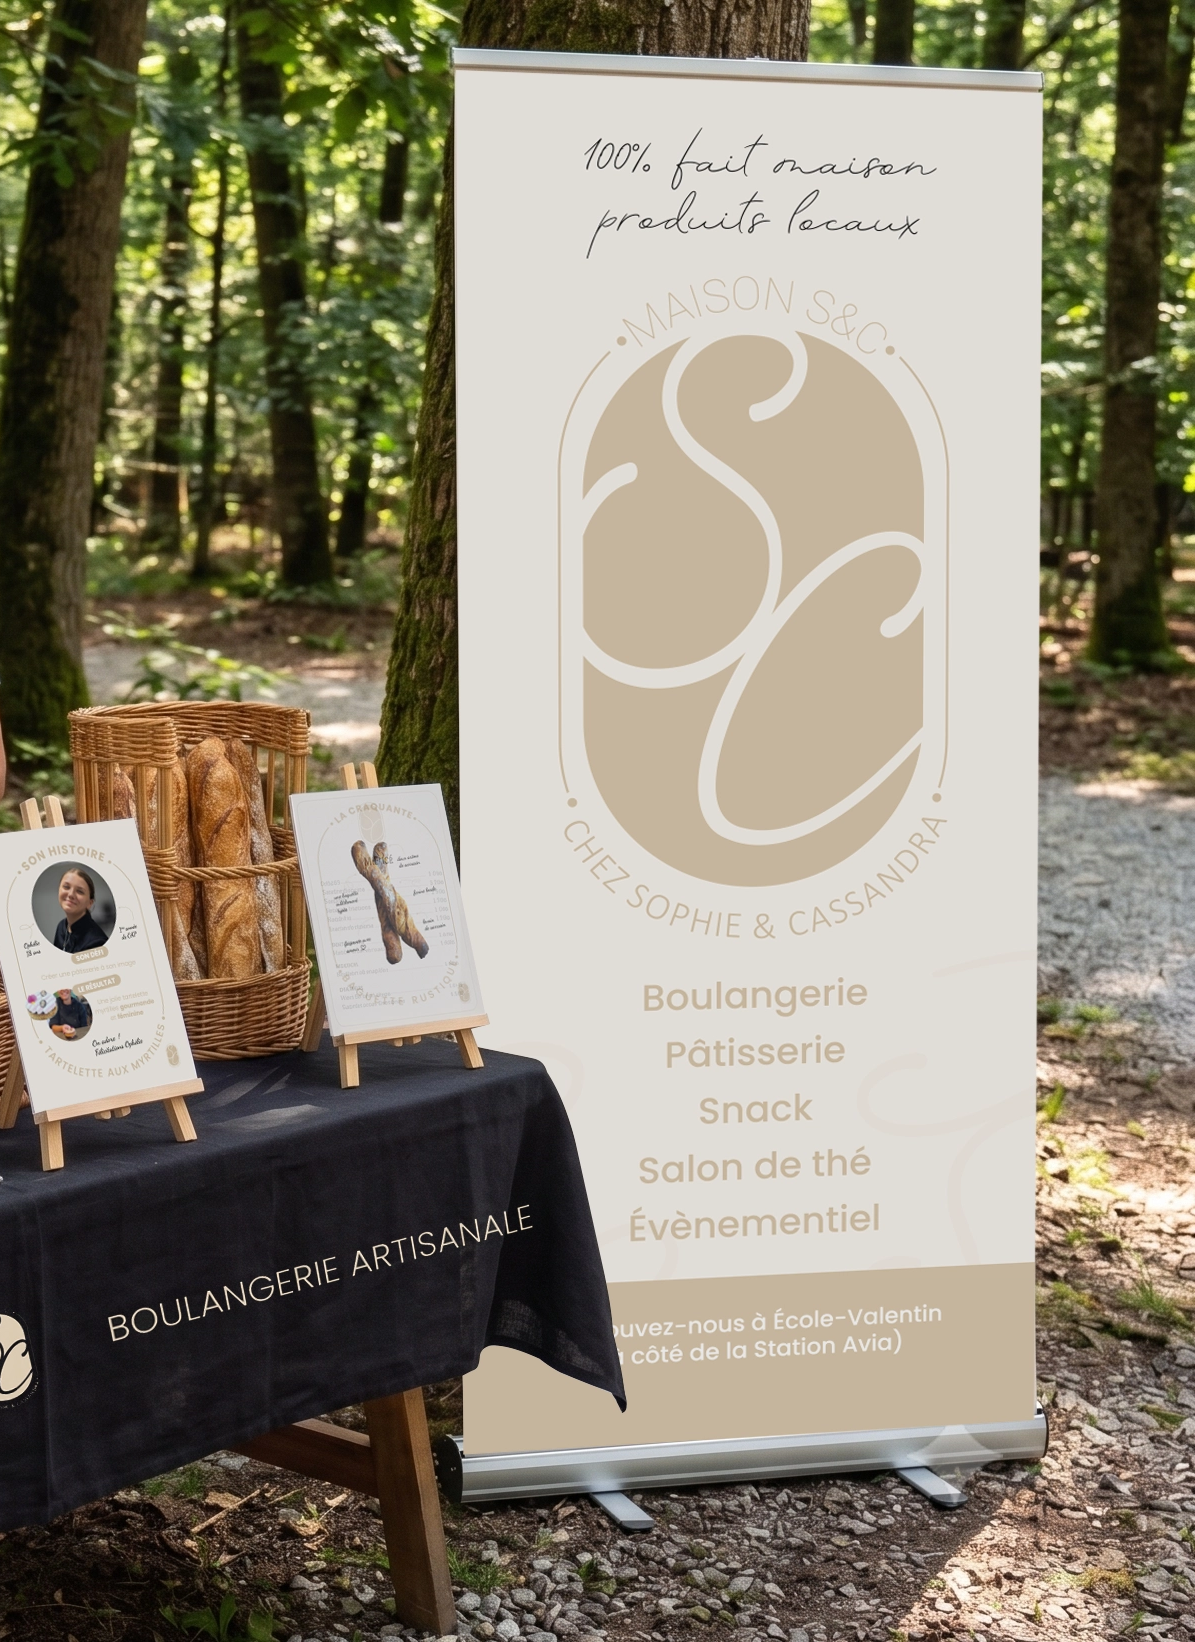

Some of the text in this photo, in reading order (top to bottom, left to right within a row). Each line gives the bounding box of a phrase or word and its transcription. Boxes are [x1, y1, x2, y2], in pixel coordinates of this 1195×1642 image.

[584, 127, 937, 191] 100% fait maison
[586, 189, 920, 259] produits locaux
[621, 275, 889, 355] MAISON S&C
[334, 802, 413, 824] LA CRAQUANTE
[21, 844, 105, 872] SON HISTOIRE
[563, 815, 948, 939] CHEZ SOPHIE & CASSANDRA
[75, 949, 104, 961] SON DÉFI
[59, 970, 70, 978] une
[77, 977, 116, 993] LE RÉSULTAT
[120, 998, 154, 1011] gourmande
[643, 976, 869, 1017] Boulangerie
[117, 1010, 144, 1020] féminine
[44, 1023, 165, 1078] TARTELETTE AUX MYRTILLES
[666, 1034, 846, 1069] Pâtisserie
[699, 1092, 814, 1125] Snack
[638, 1145, 872, 1185] Salon de thé
[629, 1202, 881, 1242] Évènementiel
[108, 1204, 534, 1342] BOULANGERIE ARTISANALE
[751, 1312, 766, 1332] à
[773, 1303, 943, 1331] École-Valentin
[631, 1343, 684, 1365] côté
[689, 1343, 719, 1362] de
[726, 1341, 747, 1360] la
[754, 1336, 836, 1359] Station
[842, 1332, 903, 1356] Avia)
